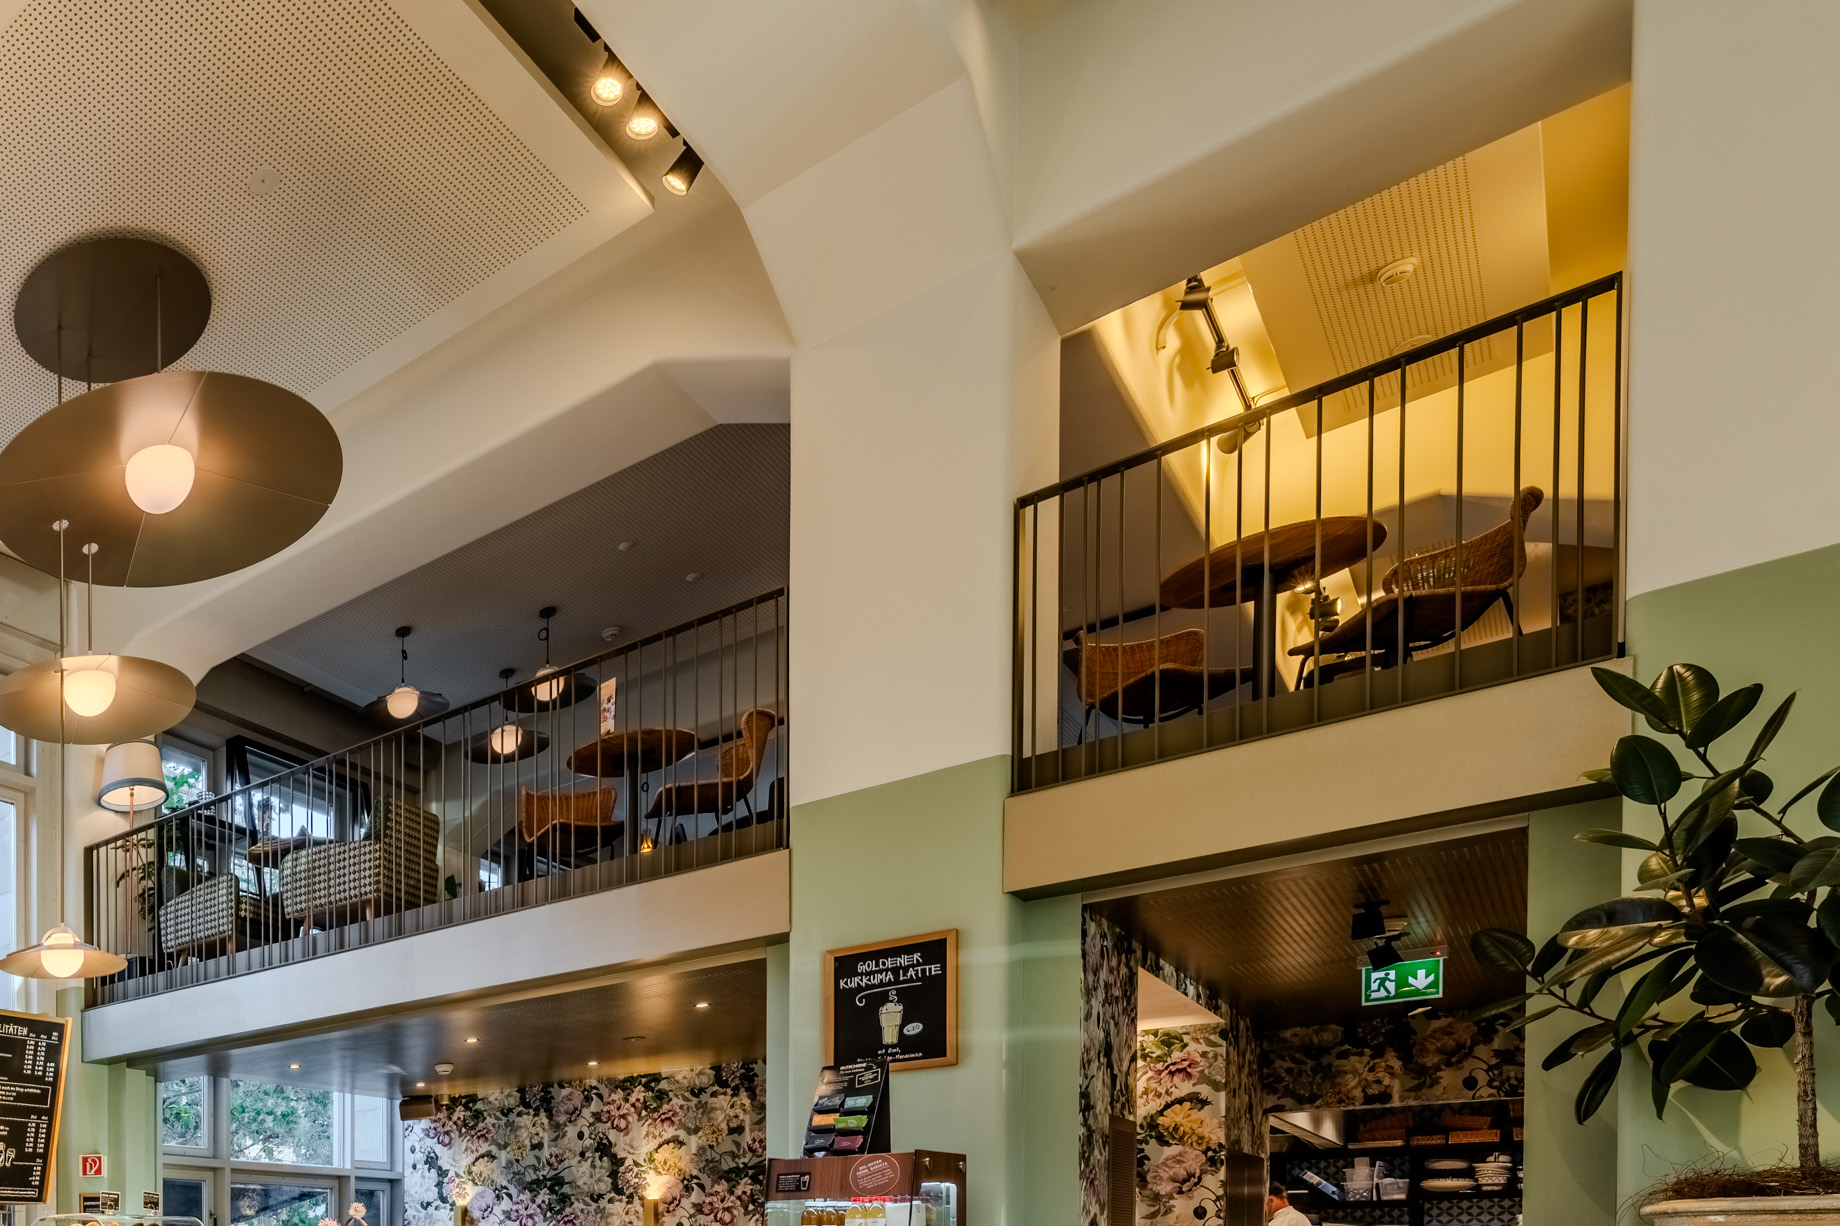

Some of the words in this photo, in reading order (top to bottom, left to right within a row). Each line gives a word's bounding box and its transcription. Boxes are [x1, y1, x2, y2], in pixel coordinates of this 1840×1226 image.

[858, 953, 922, 973] GOLDENER
[840, 971, 894, 989] KURKUMA
[899, 964, 942, 981] LATTE
